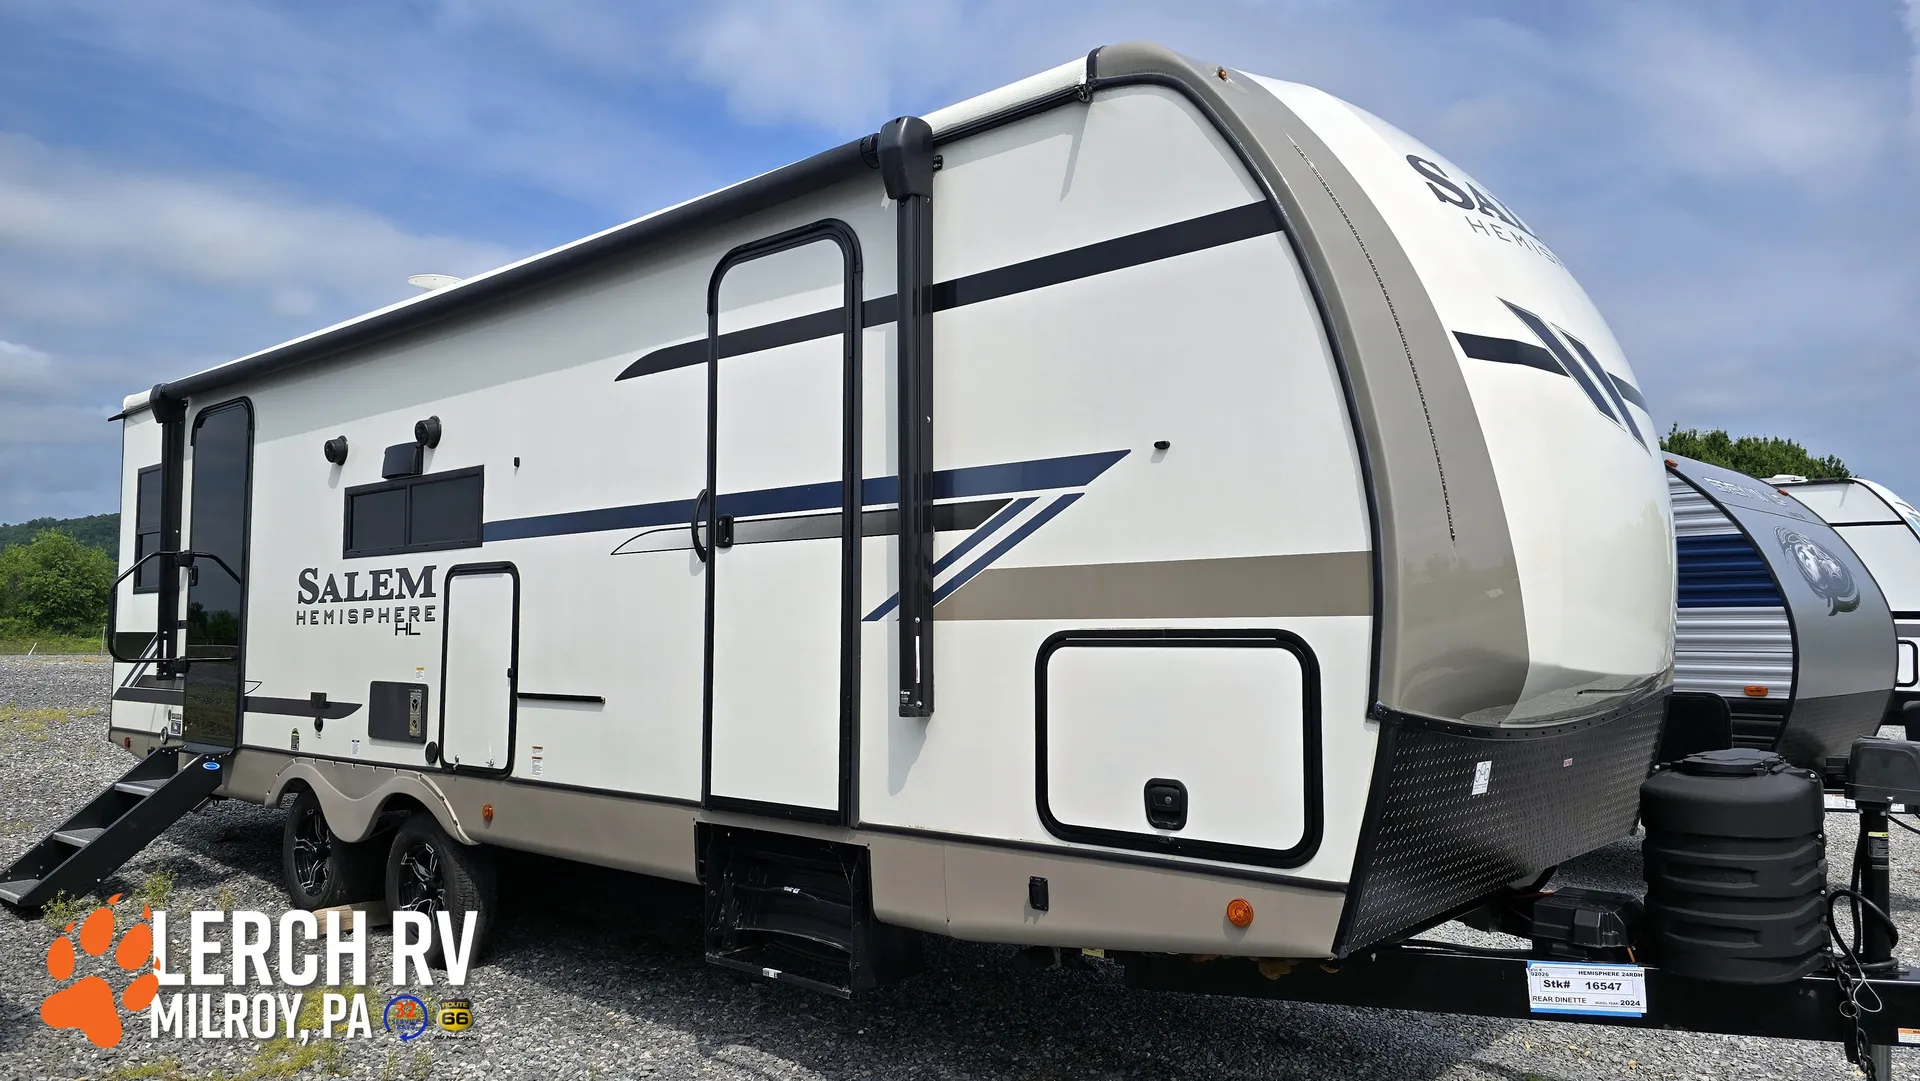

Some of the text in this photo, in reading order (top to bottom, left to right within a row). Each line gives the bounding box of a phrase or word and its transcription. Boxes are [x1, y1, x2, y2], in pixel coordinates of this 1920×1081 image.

[1406, 154, 1549, 250] SAL
[297, 564, 437, 605] SALEM
[296, 605, 437, 625] HEMISPHERE
[394, 622, 421, 636] HL
[1543, 979, 1622, 991] Stk# 16547
[1532, 995, 1587, 1004] REAR DINETTE
[1620, 999, 1641, 1007] 2024
